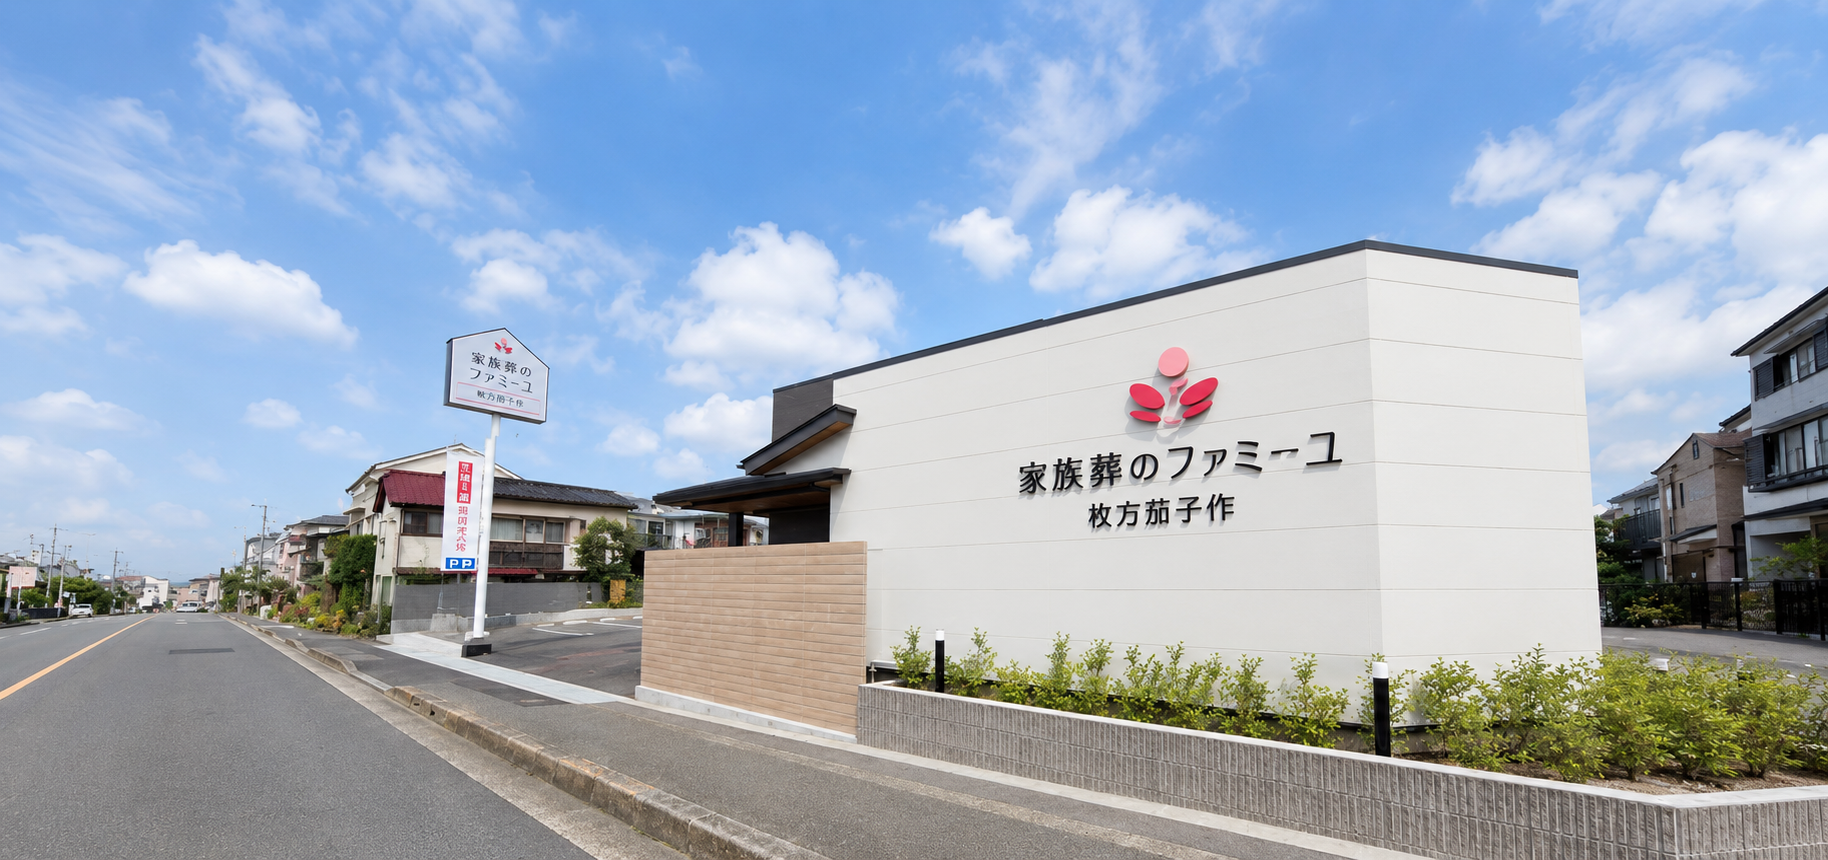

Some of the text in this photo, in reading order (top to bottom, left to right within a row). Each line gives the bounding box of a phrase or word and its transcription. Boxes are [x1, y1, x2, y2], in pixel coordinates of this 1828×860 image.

[471, 352, 532, 377] 家族葬の
[470, 367, 533, 394] ファミーユ
[1019, 431, 1343, 494] 家族葬のファミーユ
[1088, 493, 1235, 529] 枚方茄子作
